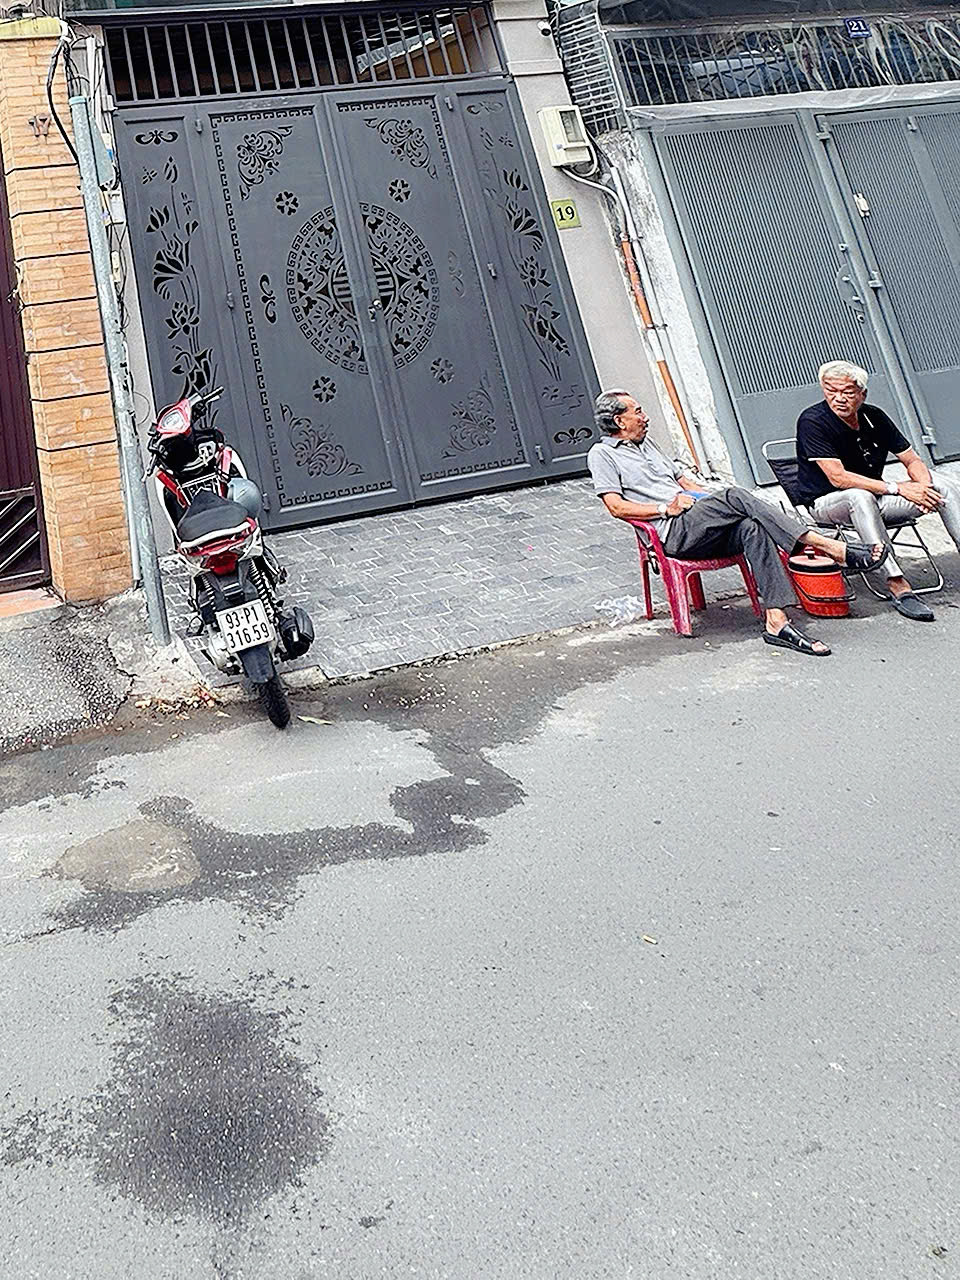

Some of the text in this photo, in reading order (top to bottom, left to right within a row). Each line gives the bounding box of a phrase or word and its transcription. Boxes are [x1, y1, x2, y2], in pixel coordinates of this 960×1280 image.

[849, 20, 866, 30] 21
[556, 205, 575, 222] 19
[227, 622, 270, 649] 316.59
